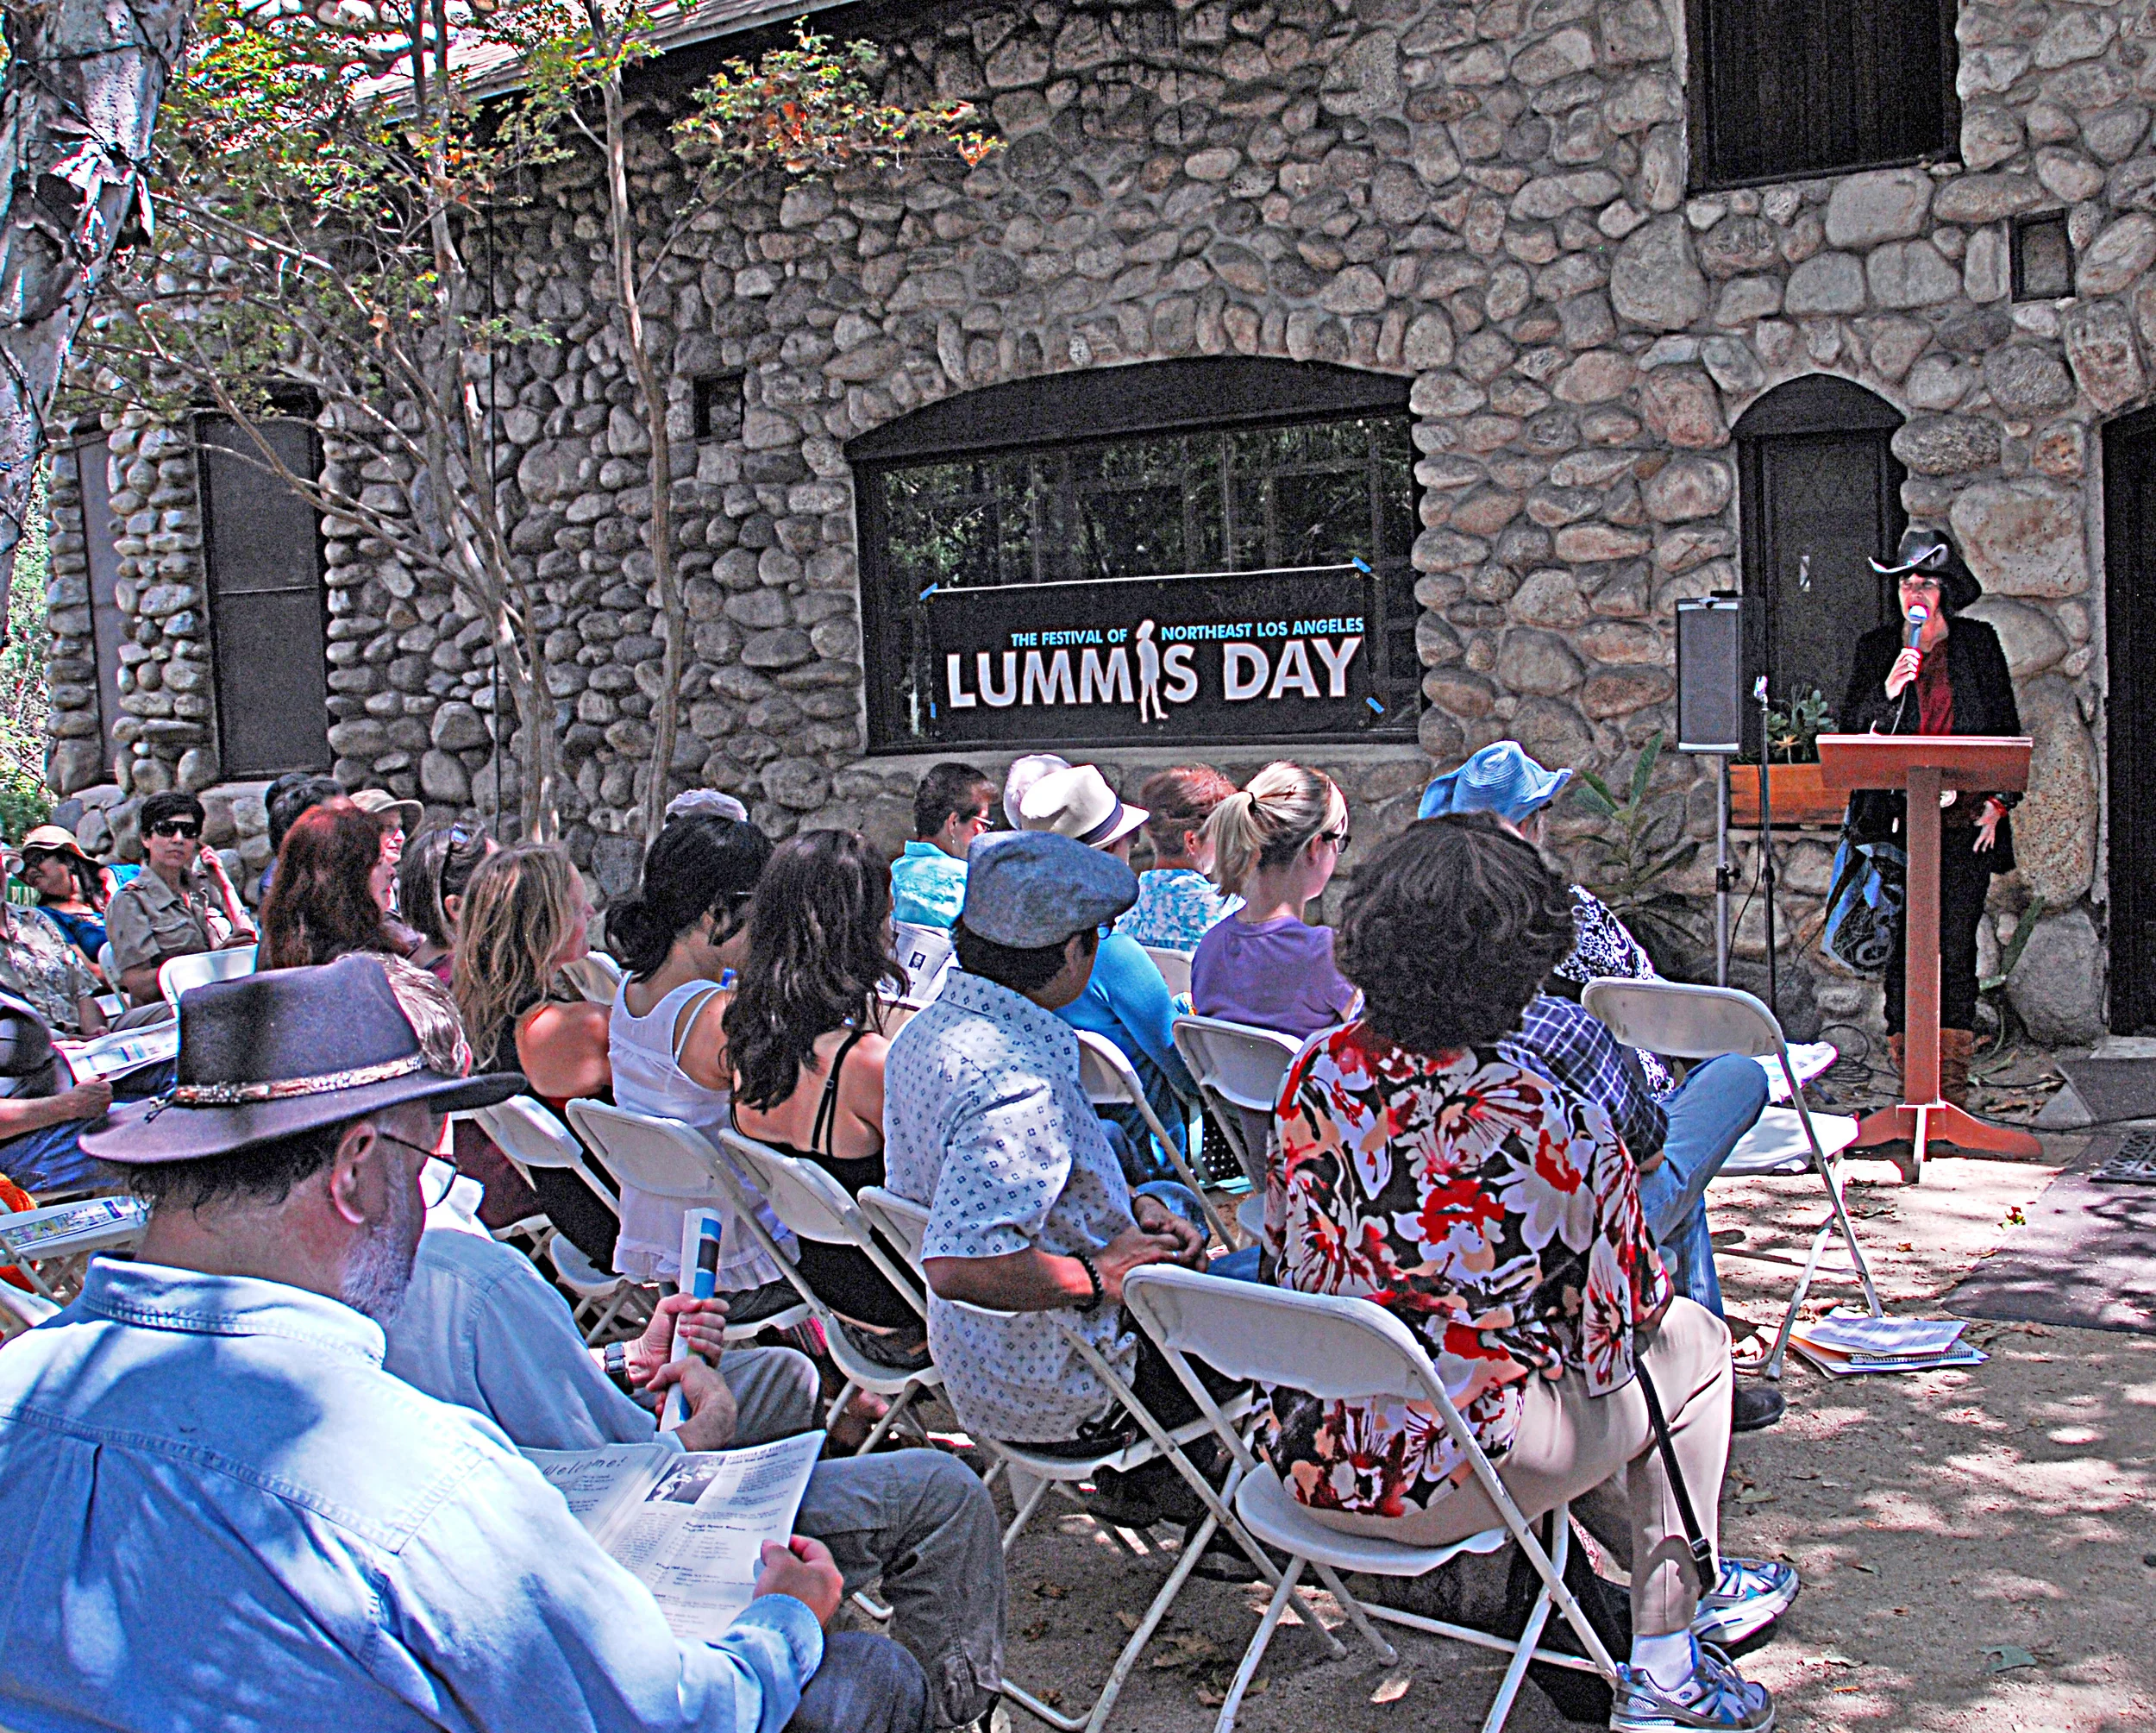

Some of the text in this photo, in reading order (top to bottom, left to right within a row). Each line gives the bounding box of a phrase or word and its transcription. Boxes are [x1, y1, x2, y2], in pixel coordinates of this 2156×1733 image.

[1011, 617, 1364, 647] THE FESTIVAL OF NORTHEAST LOS ANGELES
[1223, 636, 1363, 700] DAY
